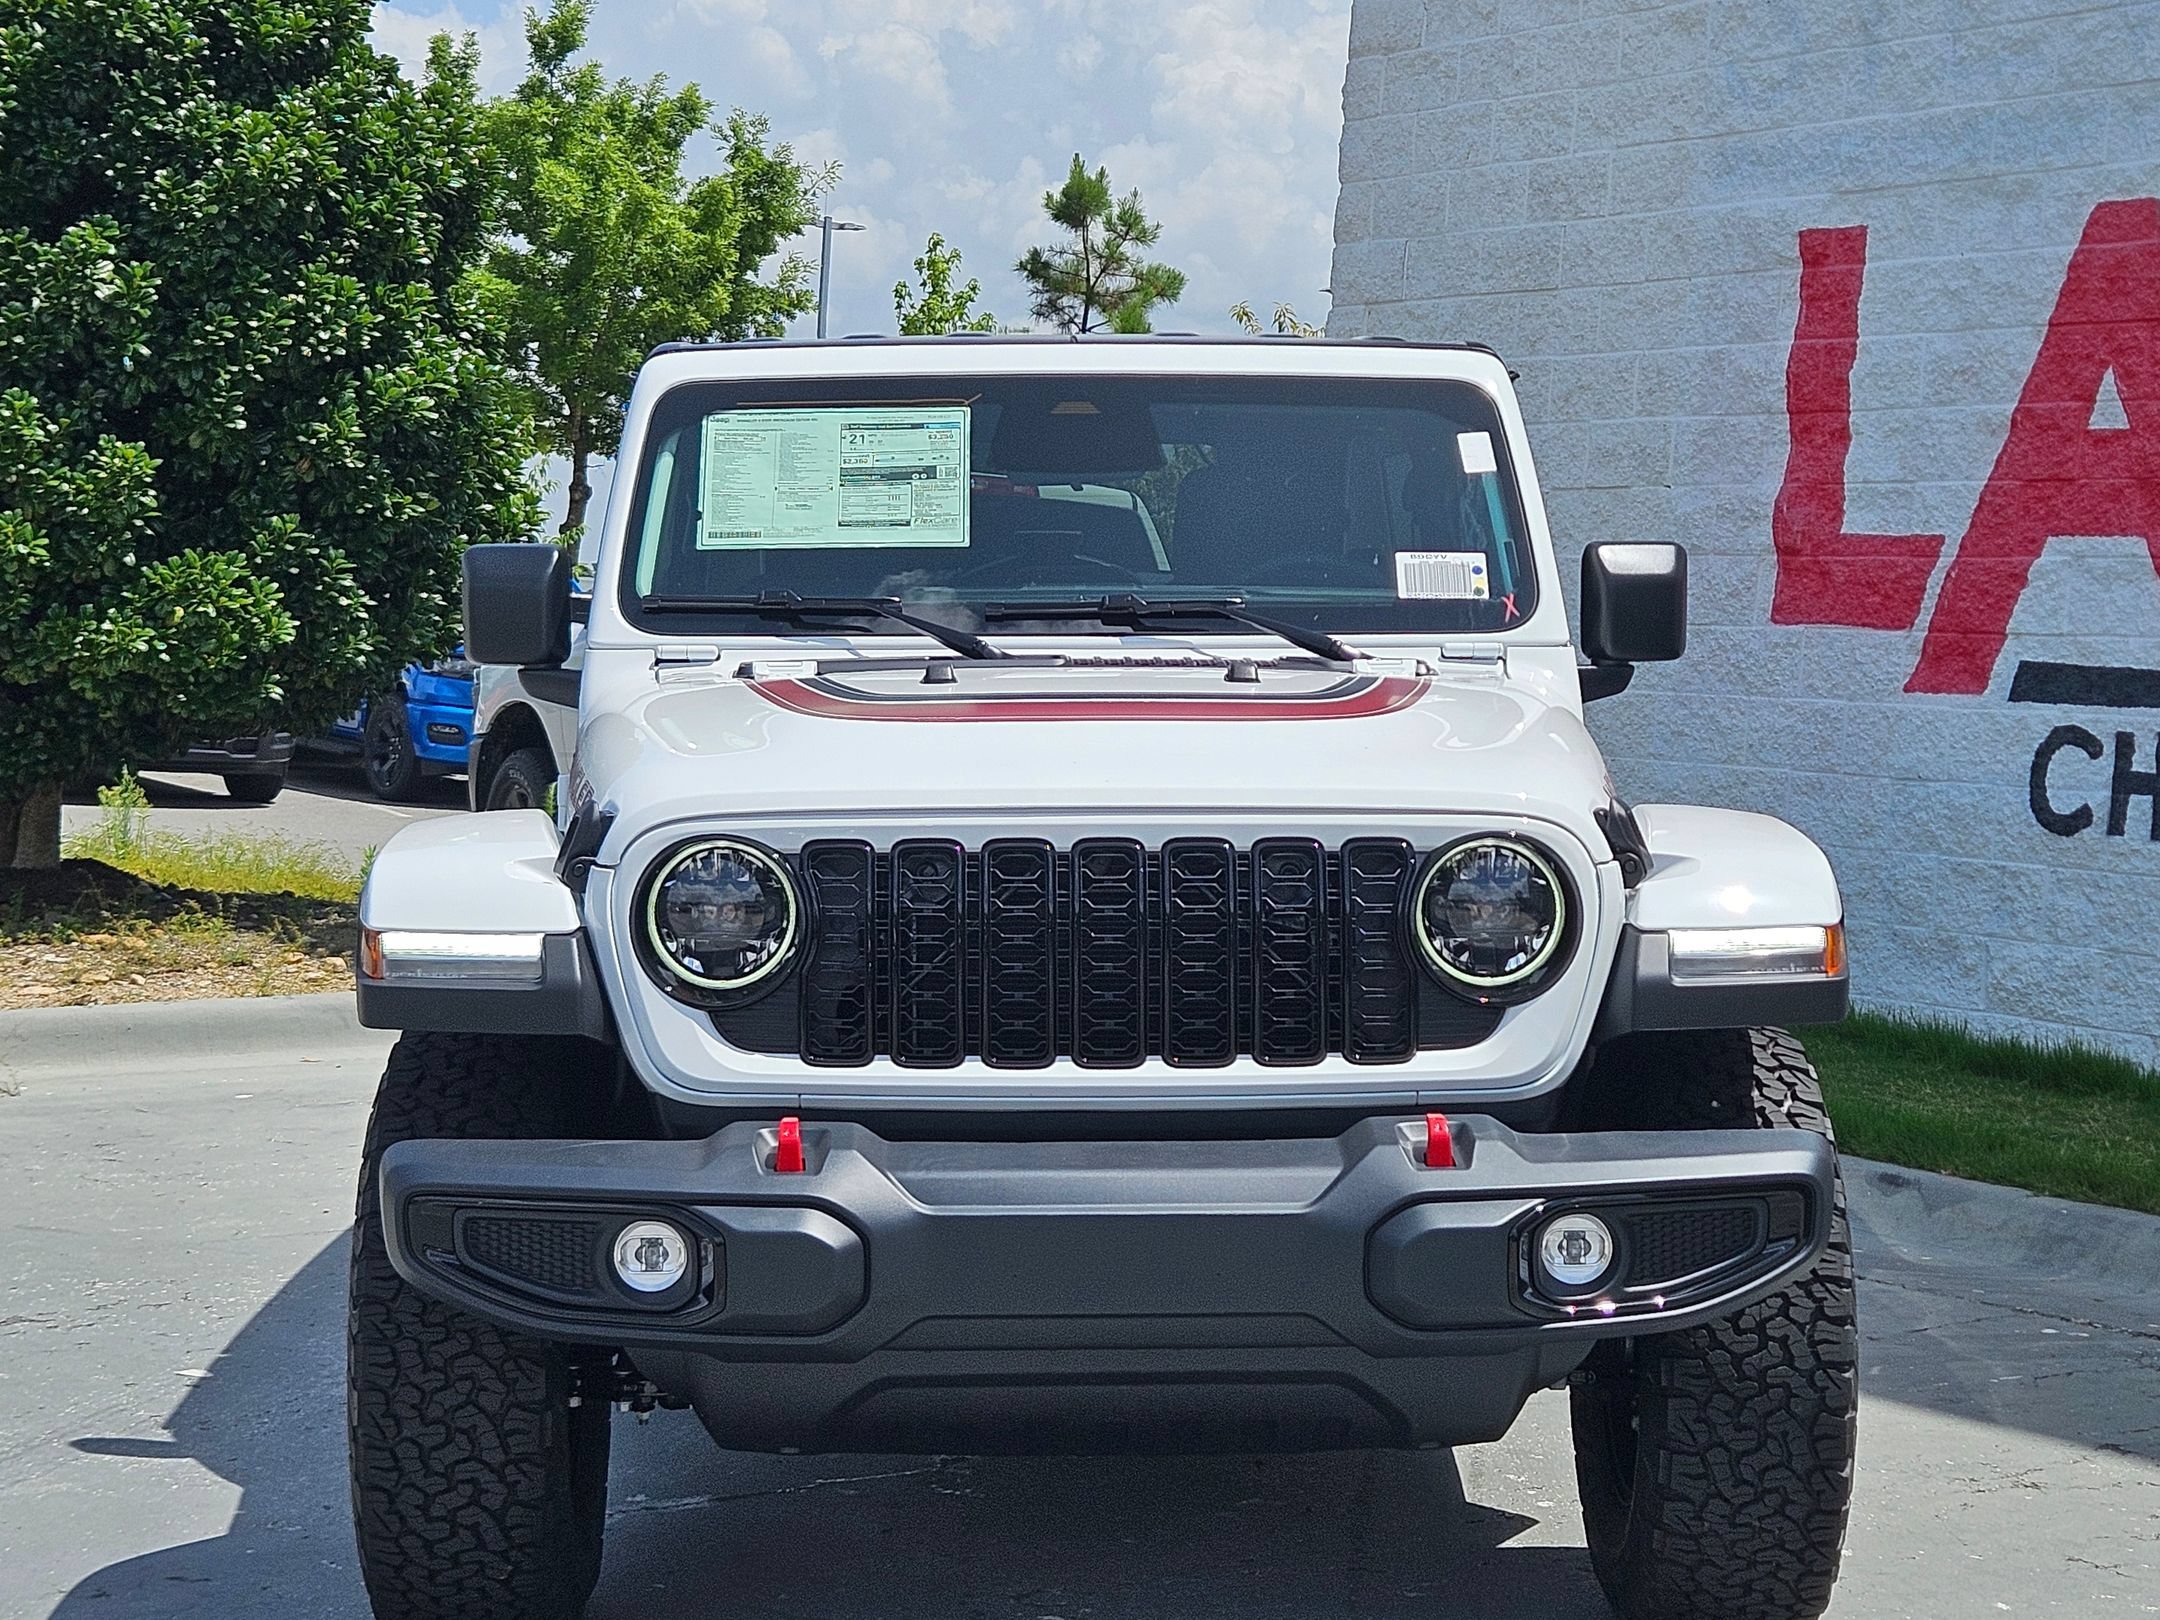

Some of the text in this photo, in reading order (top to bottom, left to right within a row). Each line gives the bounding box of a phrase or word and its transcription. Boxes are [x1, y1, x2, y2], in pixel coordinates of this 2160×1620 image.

[848, 433, 865, 444] 21
[1771, 197, 2160, 695] LA
[2029, 724, 2160, 840] CH
